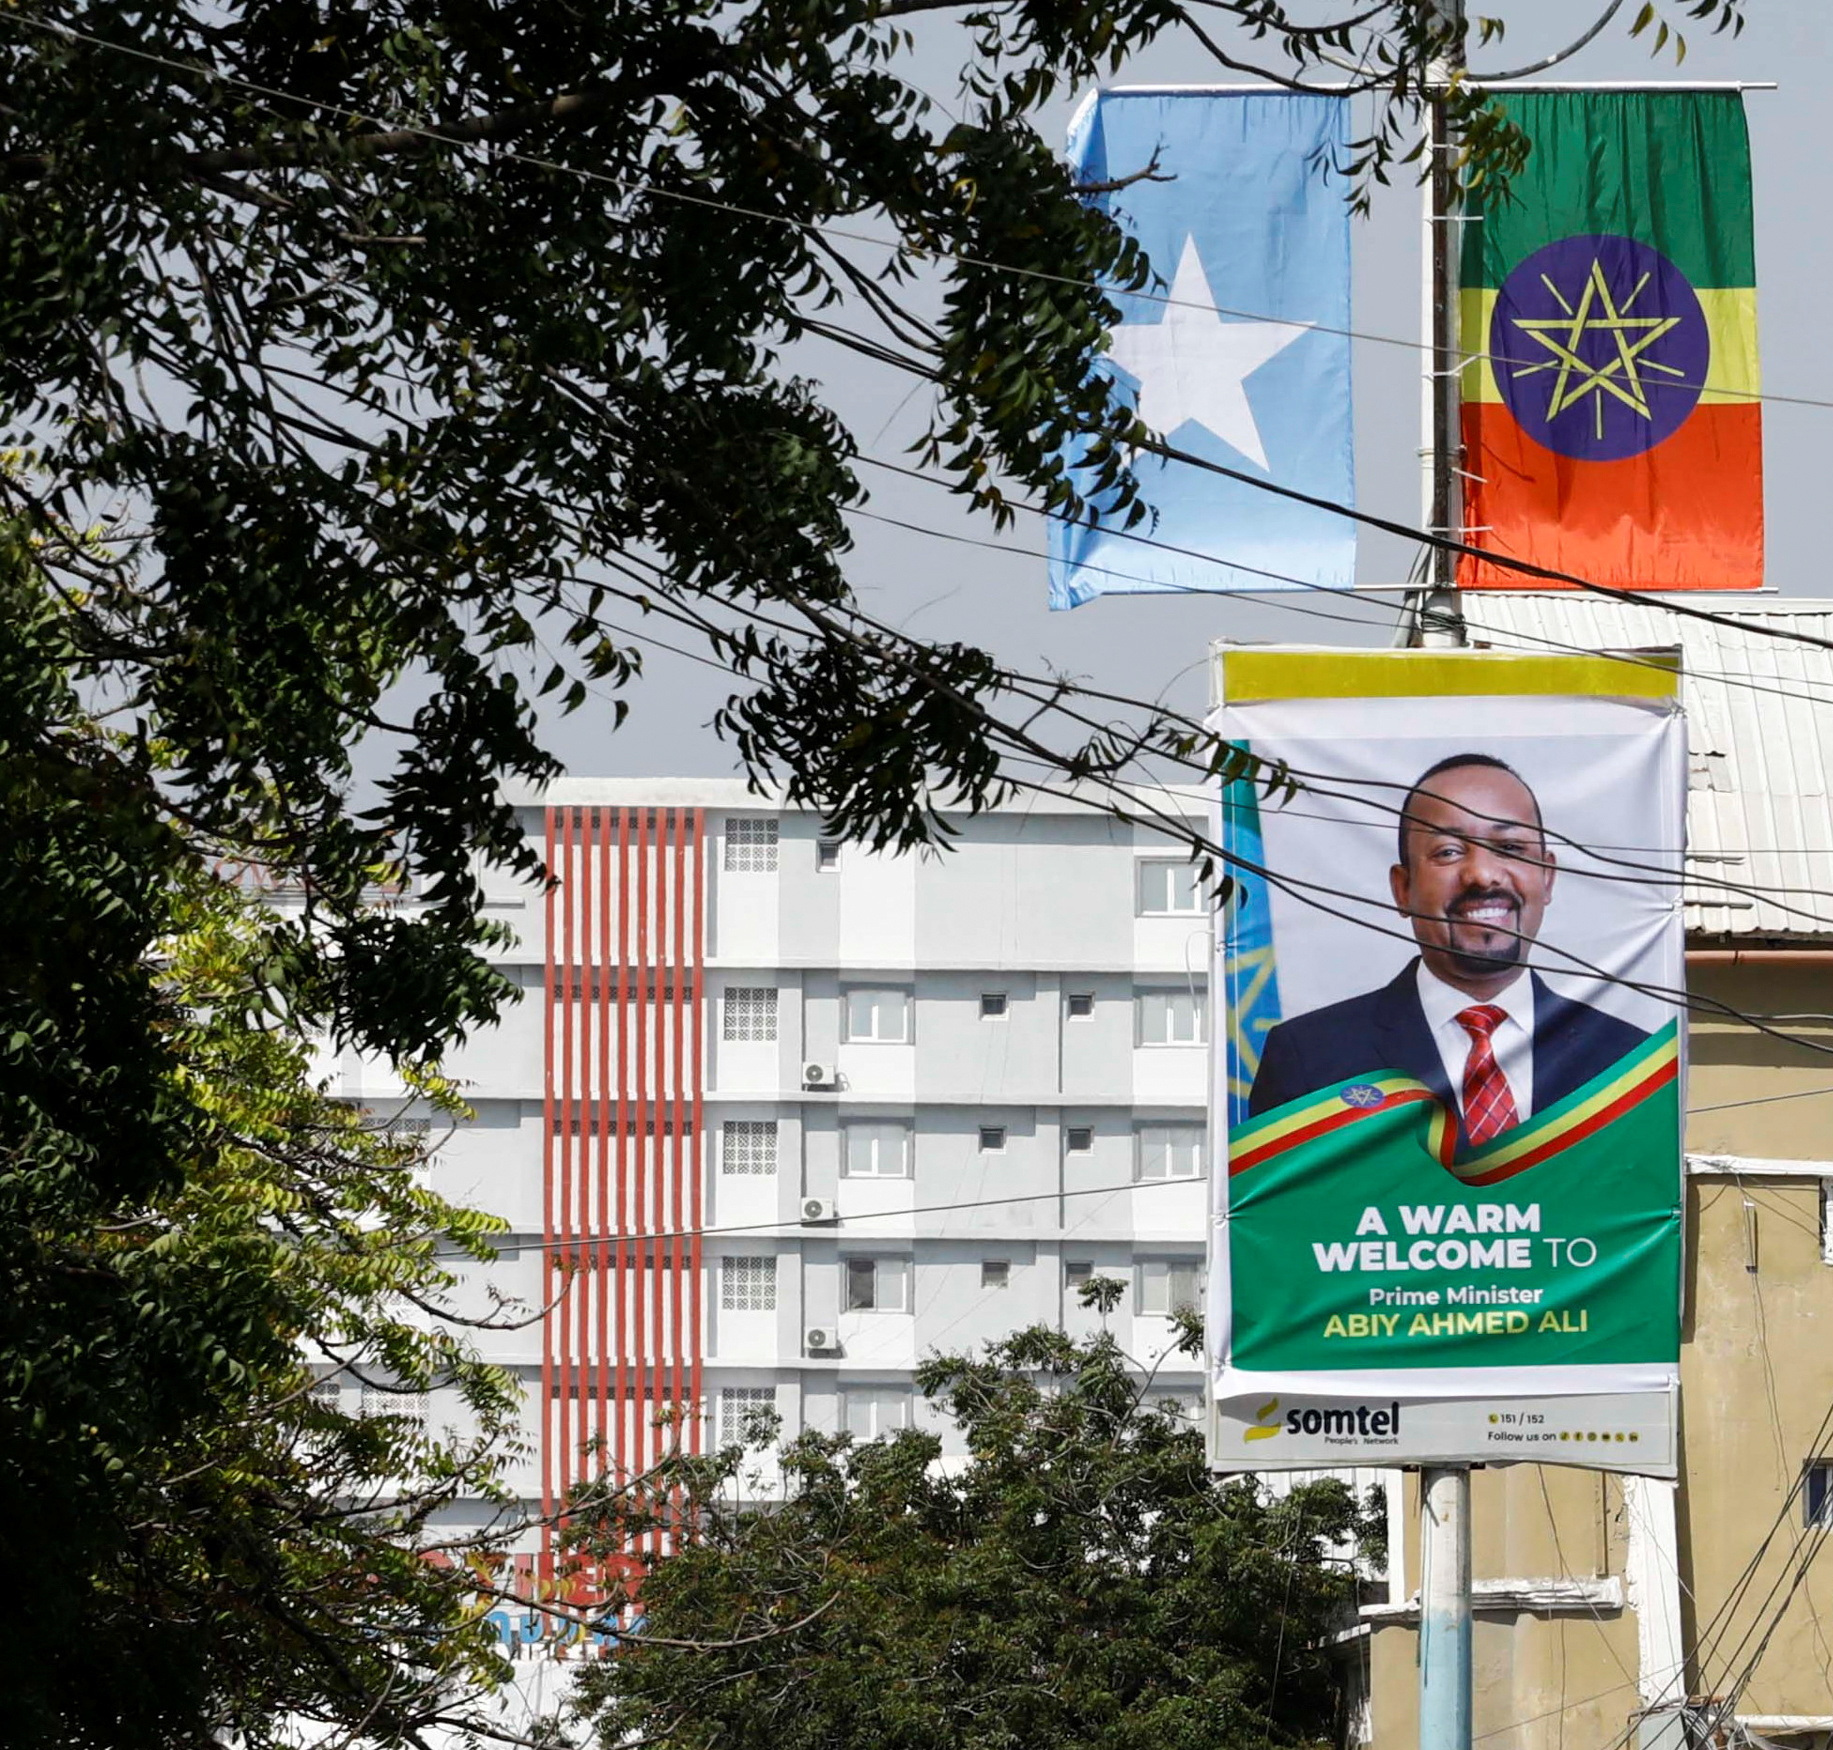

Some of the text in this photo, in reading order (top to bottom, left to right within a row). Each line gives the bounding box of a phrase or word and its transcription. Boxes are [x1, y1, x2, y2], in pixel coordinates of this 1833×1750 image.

[1356, 1203, 1540, 1236] A WARM
[1312, 1238, 1597, 1272] WELCOME TO
[1369, 1286, 1543, 1307] Prime Minister
[1323, 1309, 1588, 1338] ABIY AHMED ALI
[1286, 1402, 1400, 1437] somtel
[1499, 1413, 1516, 1425] 151
[1526, 1413, 1545, 1425] 152
[1363, 1436, 1400, 1446] Network
[1488, 1431, 1557, 1443] Follow us on
